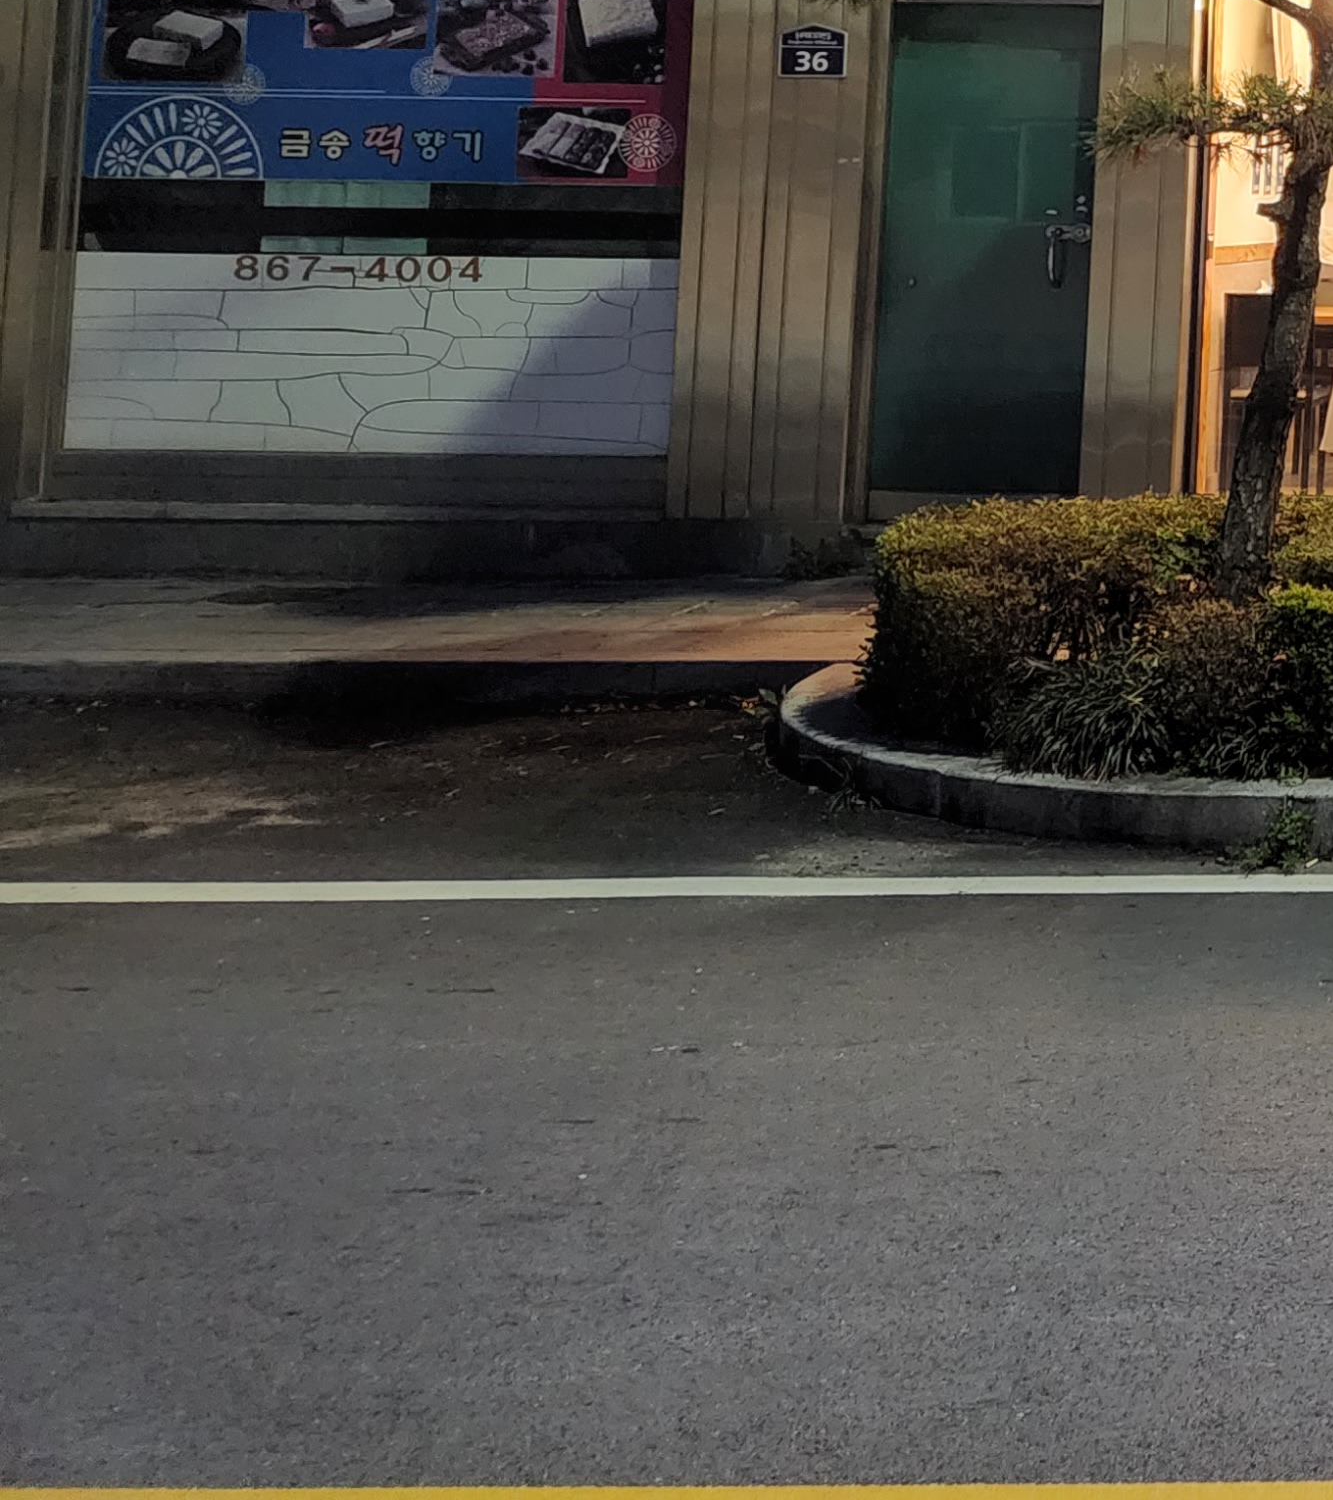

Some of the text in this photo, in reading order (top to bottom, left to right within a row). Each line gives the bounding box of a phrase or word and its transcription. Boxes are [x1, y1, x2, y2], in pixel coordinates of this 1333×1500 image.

[794, 51, 829, 72] 36
[279, 124, 485, 166] 금송 떡 향기
[234, 255, 484, 283] 867-4004
